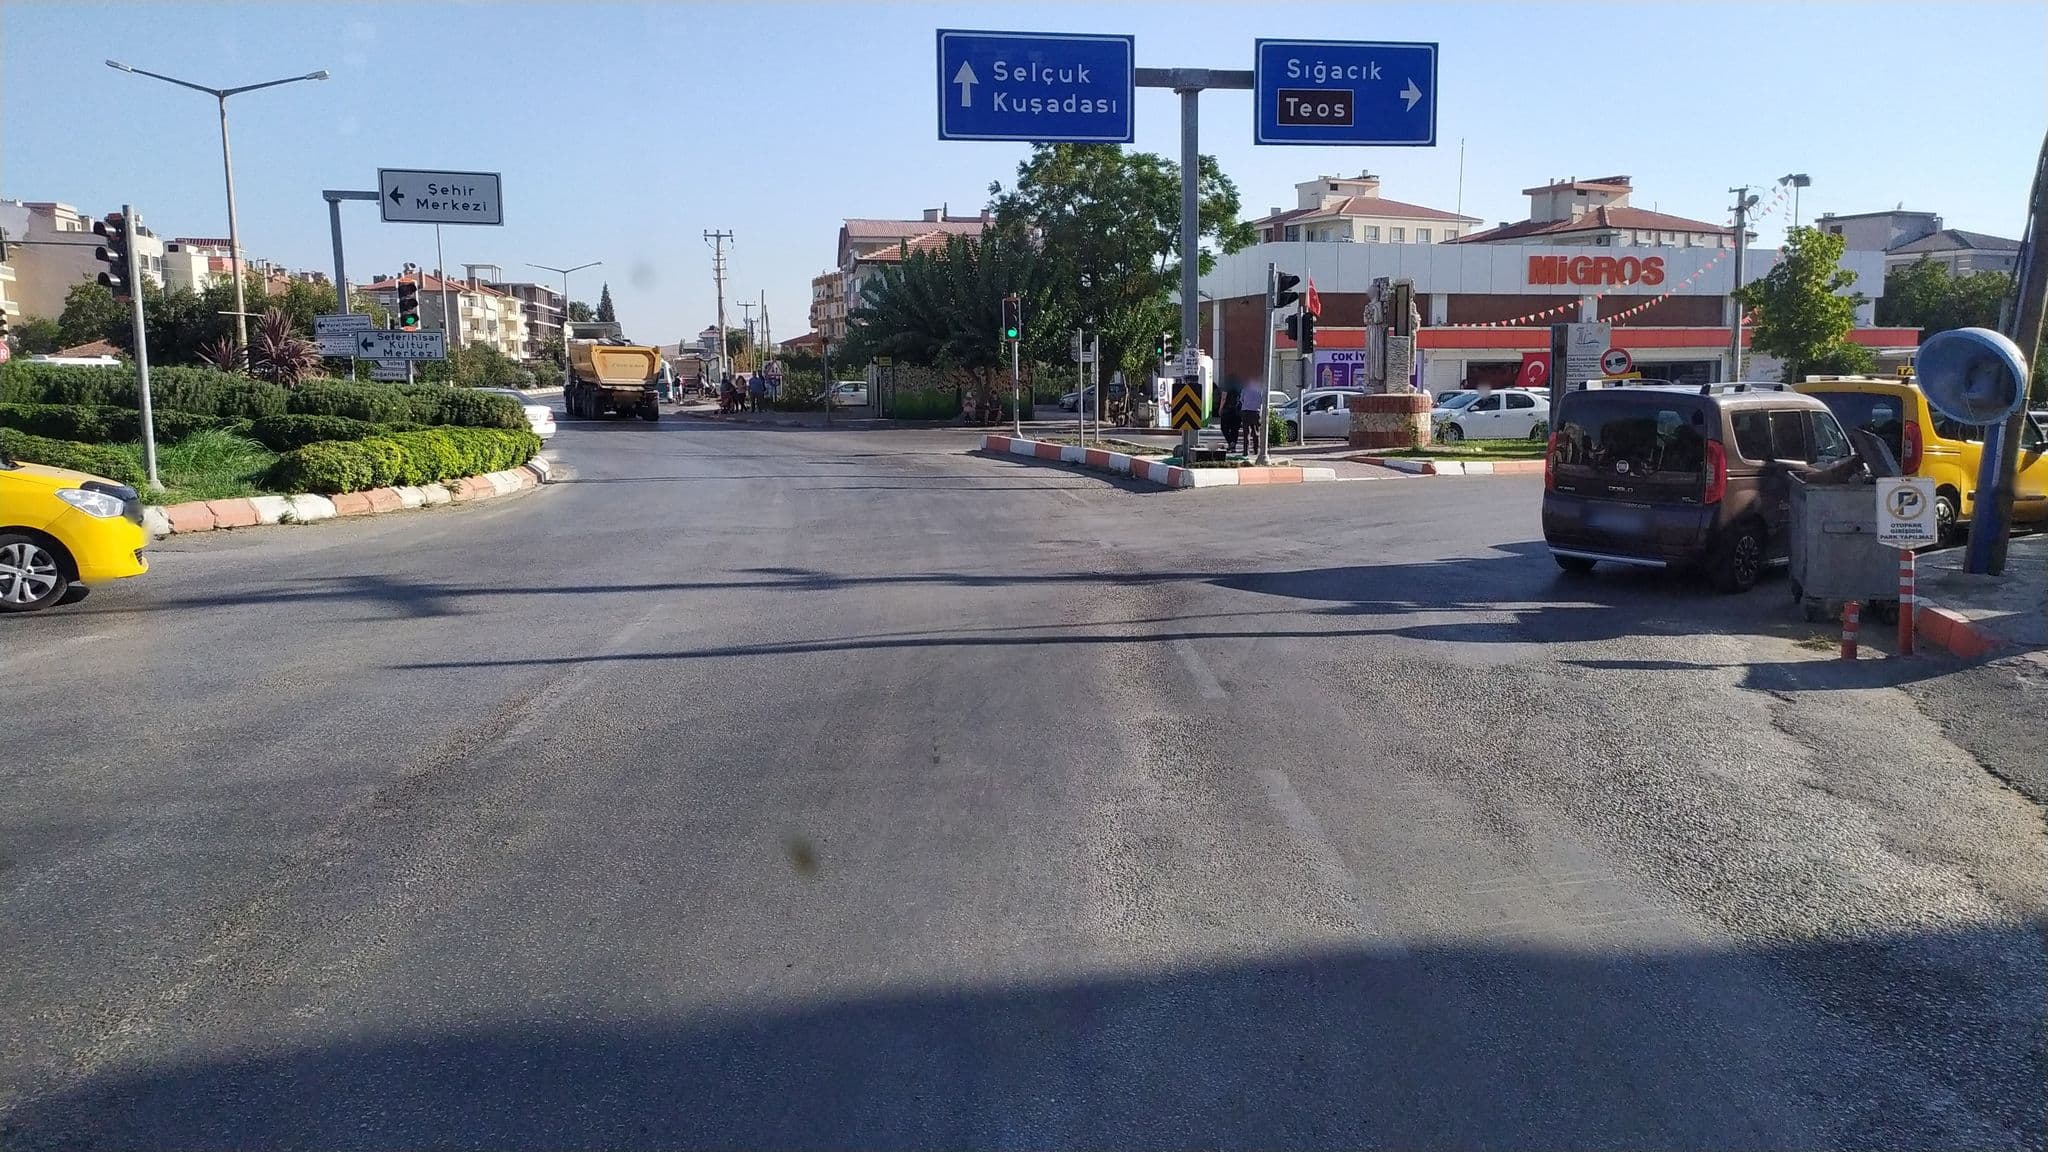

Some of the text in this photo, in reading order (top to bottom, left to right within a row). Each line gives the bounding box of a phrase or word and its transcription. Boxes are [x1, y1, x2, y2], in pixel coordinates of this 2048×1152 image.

[993, 61, 1091, 85] Selçuk
[1286, 58, 1383, 84] Sığacık
[993, 92, 1117, 115] Kuşadası
[1285, 97, 1345, 117] Teos
[428, 183, 475, 196] Şehir
[416, 198, 487, 211] Merkezi
[377, 332, 440, 342] Seferihisar
[389, 340, 430, 350] Kültür
[383, 349, 438, 357] Merkezi
[1331, 352, 1353, 362] ÇOK
